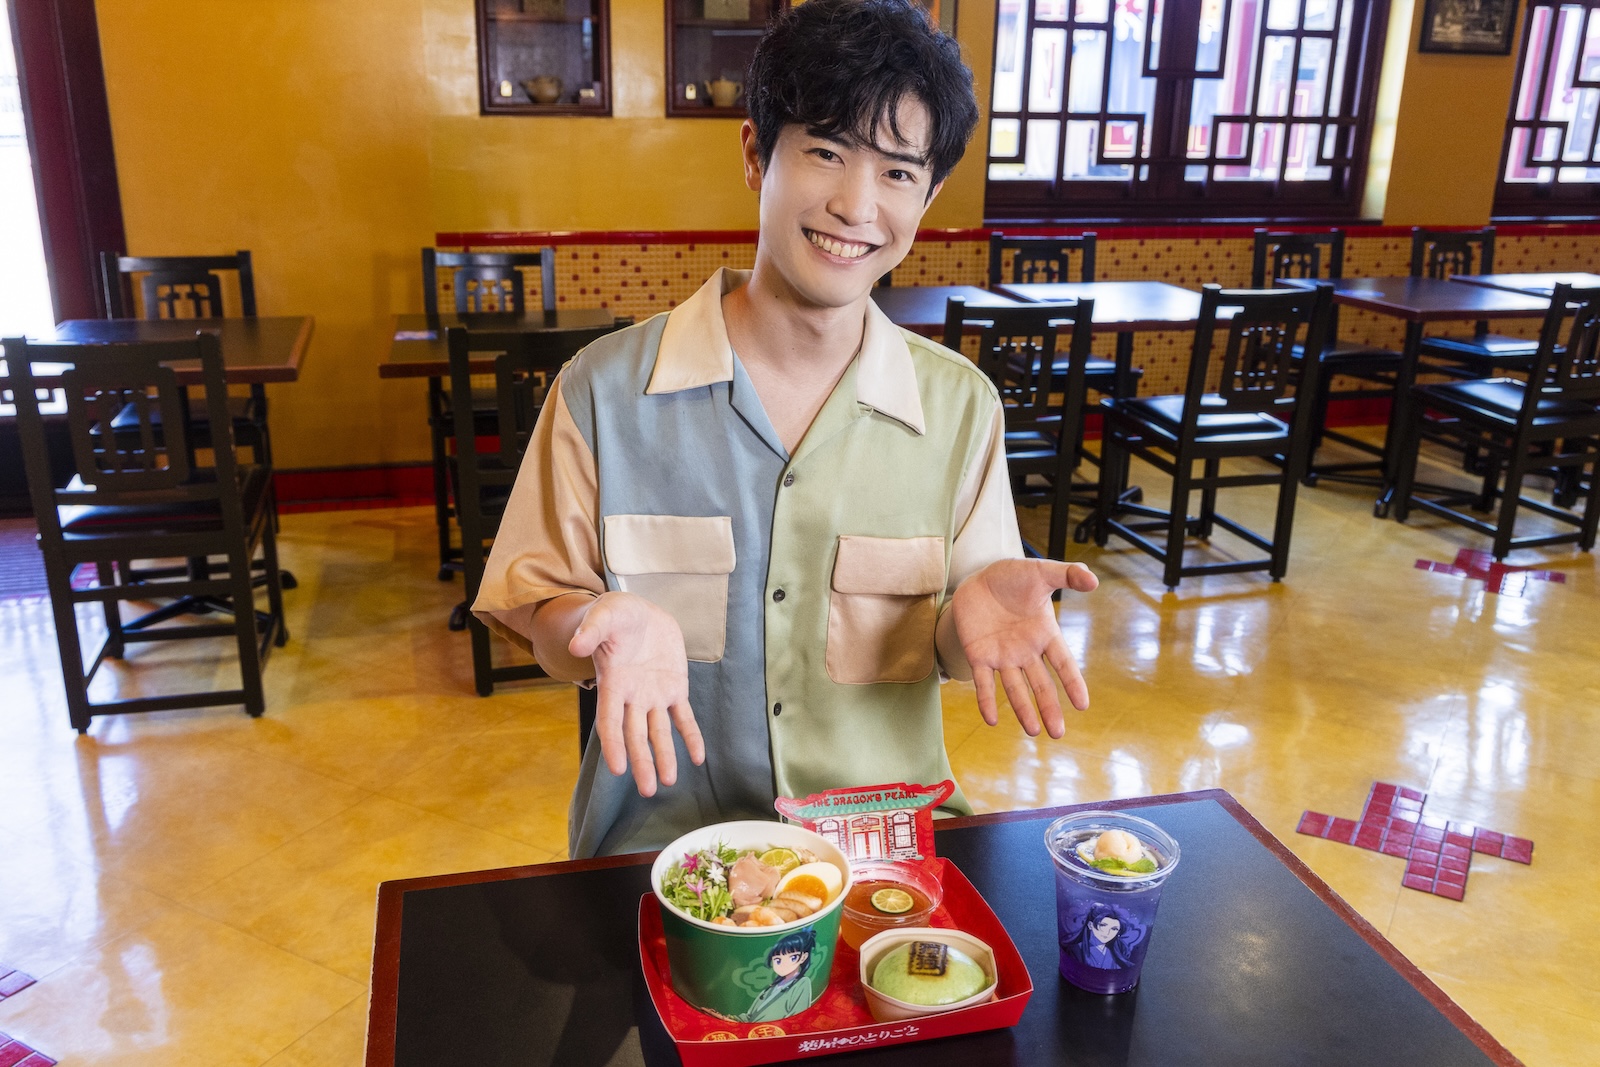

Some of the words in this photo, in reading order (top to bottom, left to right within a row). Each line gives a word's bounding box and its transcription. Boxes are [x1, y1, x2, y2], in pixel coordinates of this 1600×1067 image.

[812, 798, 831, 808] THE
[833, 793, 882, 806] DRAGON'S
[884, 791, 918, 801] PEARL
[798, 1025, 919, 1052] 薬屋のひとりごと
